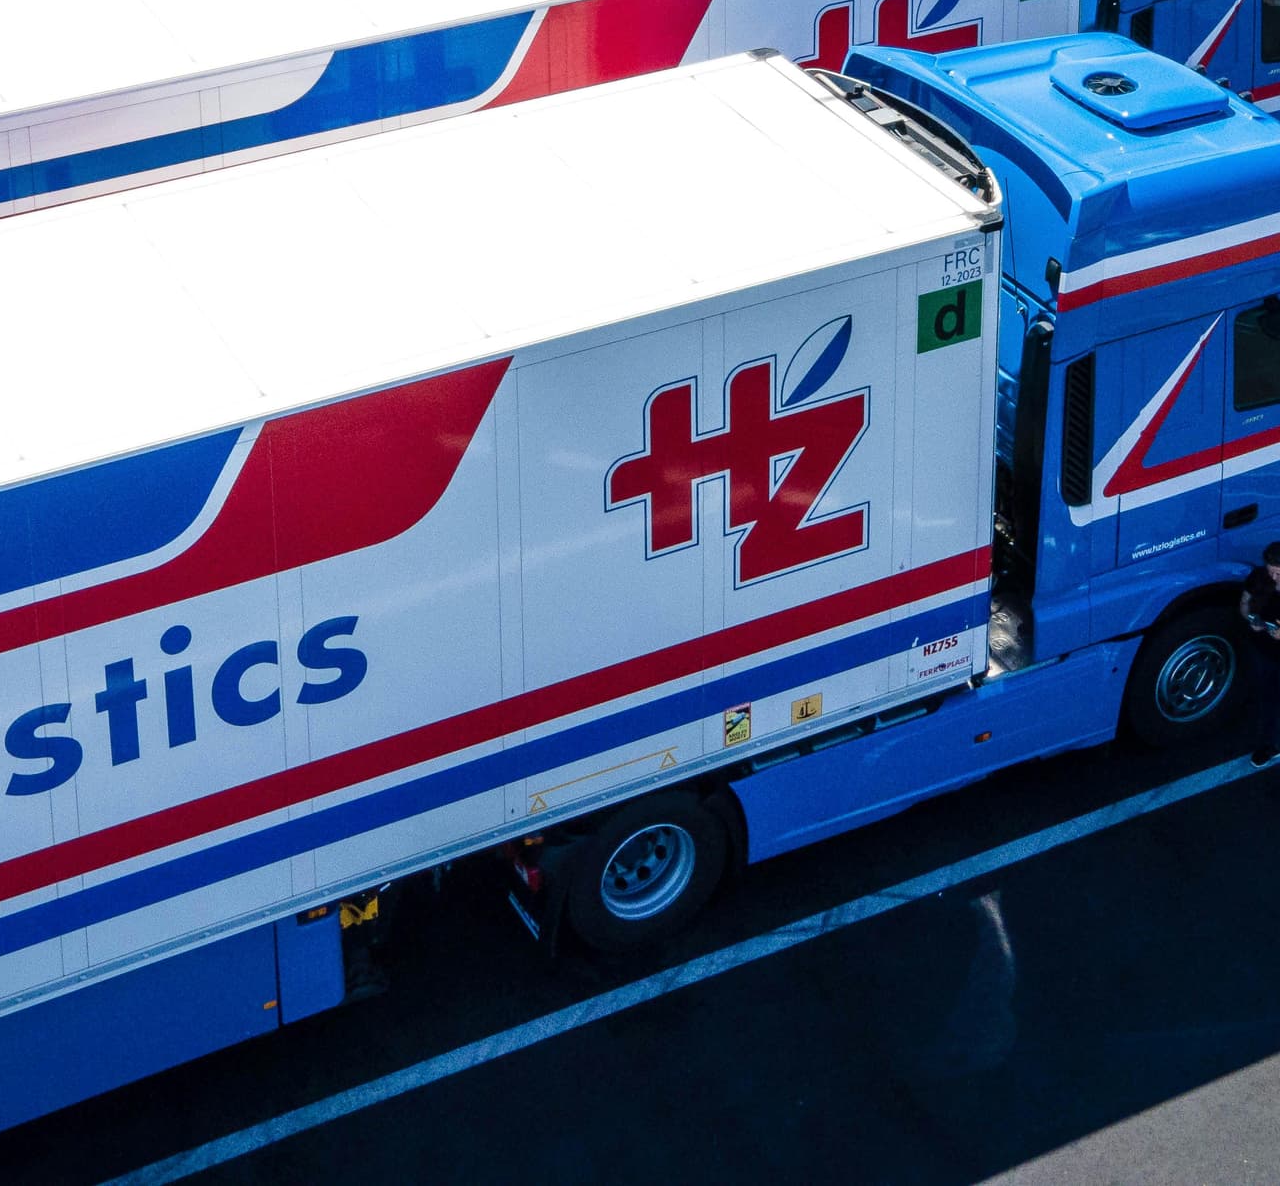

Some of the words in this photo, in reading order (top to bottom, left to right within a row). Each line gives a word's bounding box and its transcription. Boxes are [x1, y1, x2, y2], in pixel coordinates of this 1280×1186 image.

[944, 246, 980, 272] FRC
[941, 266, 981, 287] 12-2023
[934, 289, 967, 341] d
[605, 354, 871, 591] HZ
[1131, 528, 1207, 560] www.hzlogistics.eu
[923, 635, 959, 657] HZ755
[919, 655, 970, 679] FERROPLAST
